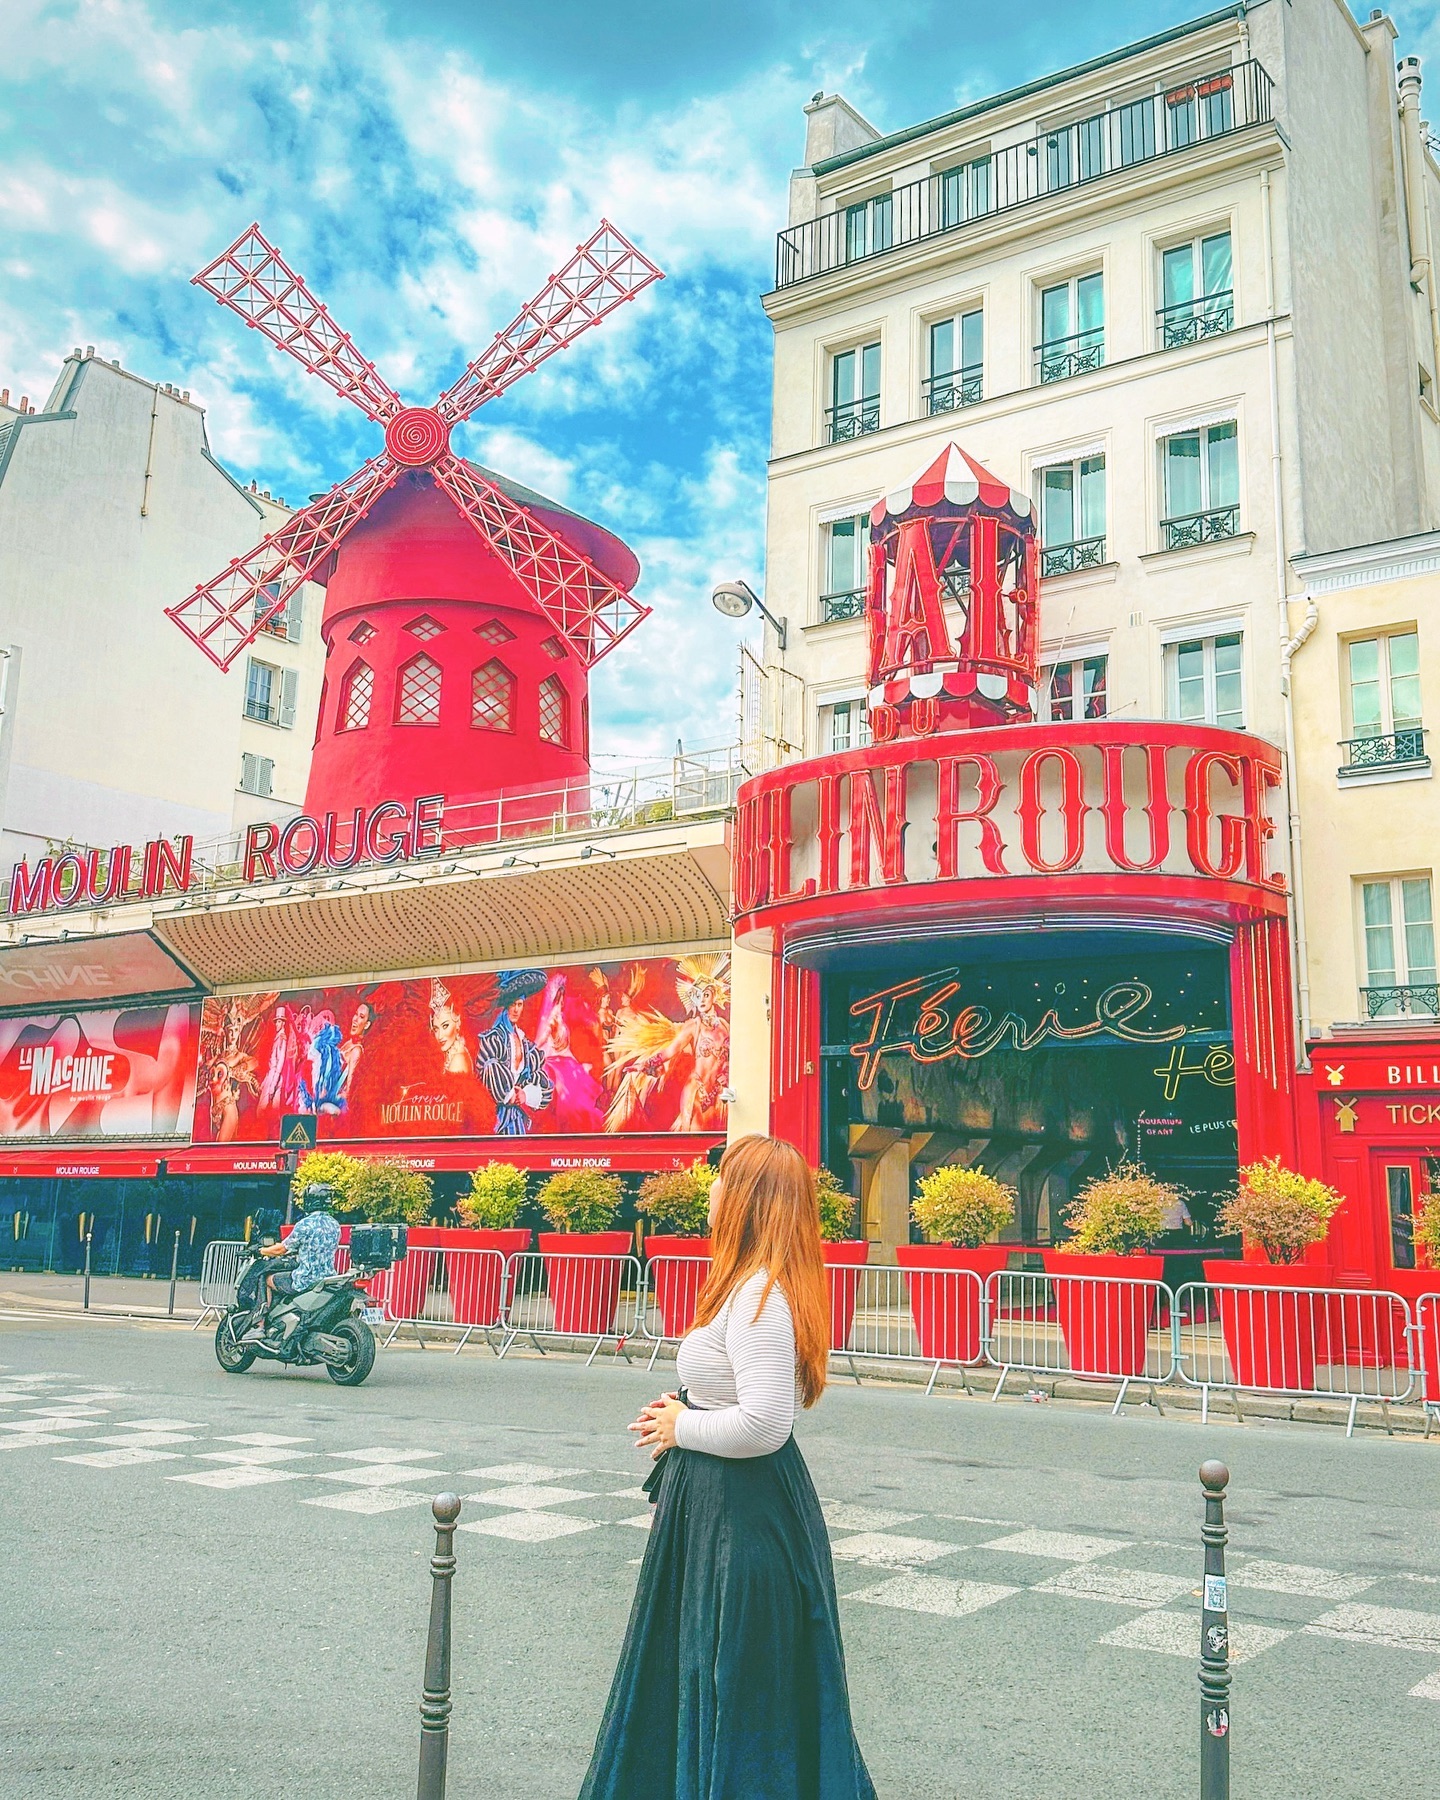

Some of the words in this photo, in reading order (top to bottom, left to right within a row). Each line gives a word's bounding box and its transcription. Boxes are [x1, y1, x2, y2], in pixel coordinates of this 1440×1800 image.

[932, 744, 1287, 892] ROUGE
[8, 834, 193, 914] MOULIN
[243, 793, 446, 883] ROUGE
[394, 1082, 448, 1105] Forever
[381, 1104, 423, 1124] MOULIN
[424, 1102, 464, 1123] ROUGE
[1385, 1104, 1440, 1124] TICK
[1189, 1124, 1202, 1134] LE
[1202, 1120, 1226, 1132] PLUS
[55, 1166, 79, 1175] MOULIN
[79, 1166, 100, 1174] ROUGE
[233, 1162, 258, 1170] MOULIN
[258, 1161, 277, 1170] ROUG
[551, 1158, 582, 1168] MOULIN
[583, 1157, 612, 1168] ROUGE
